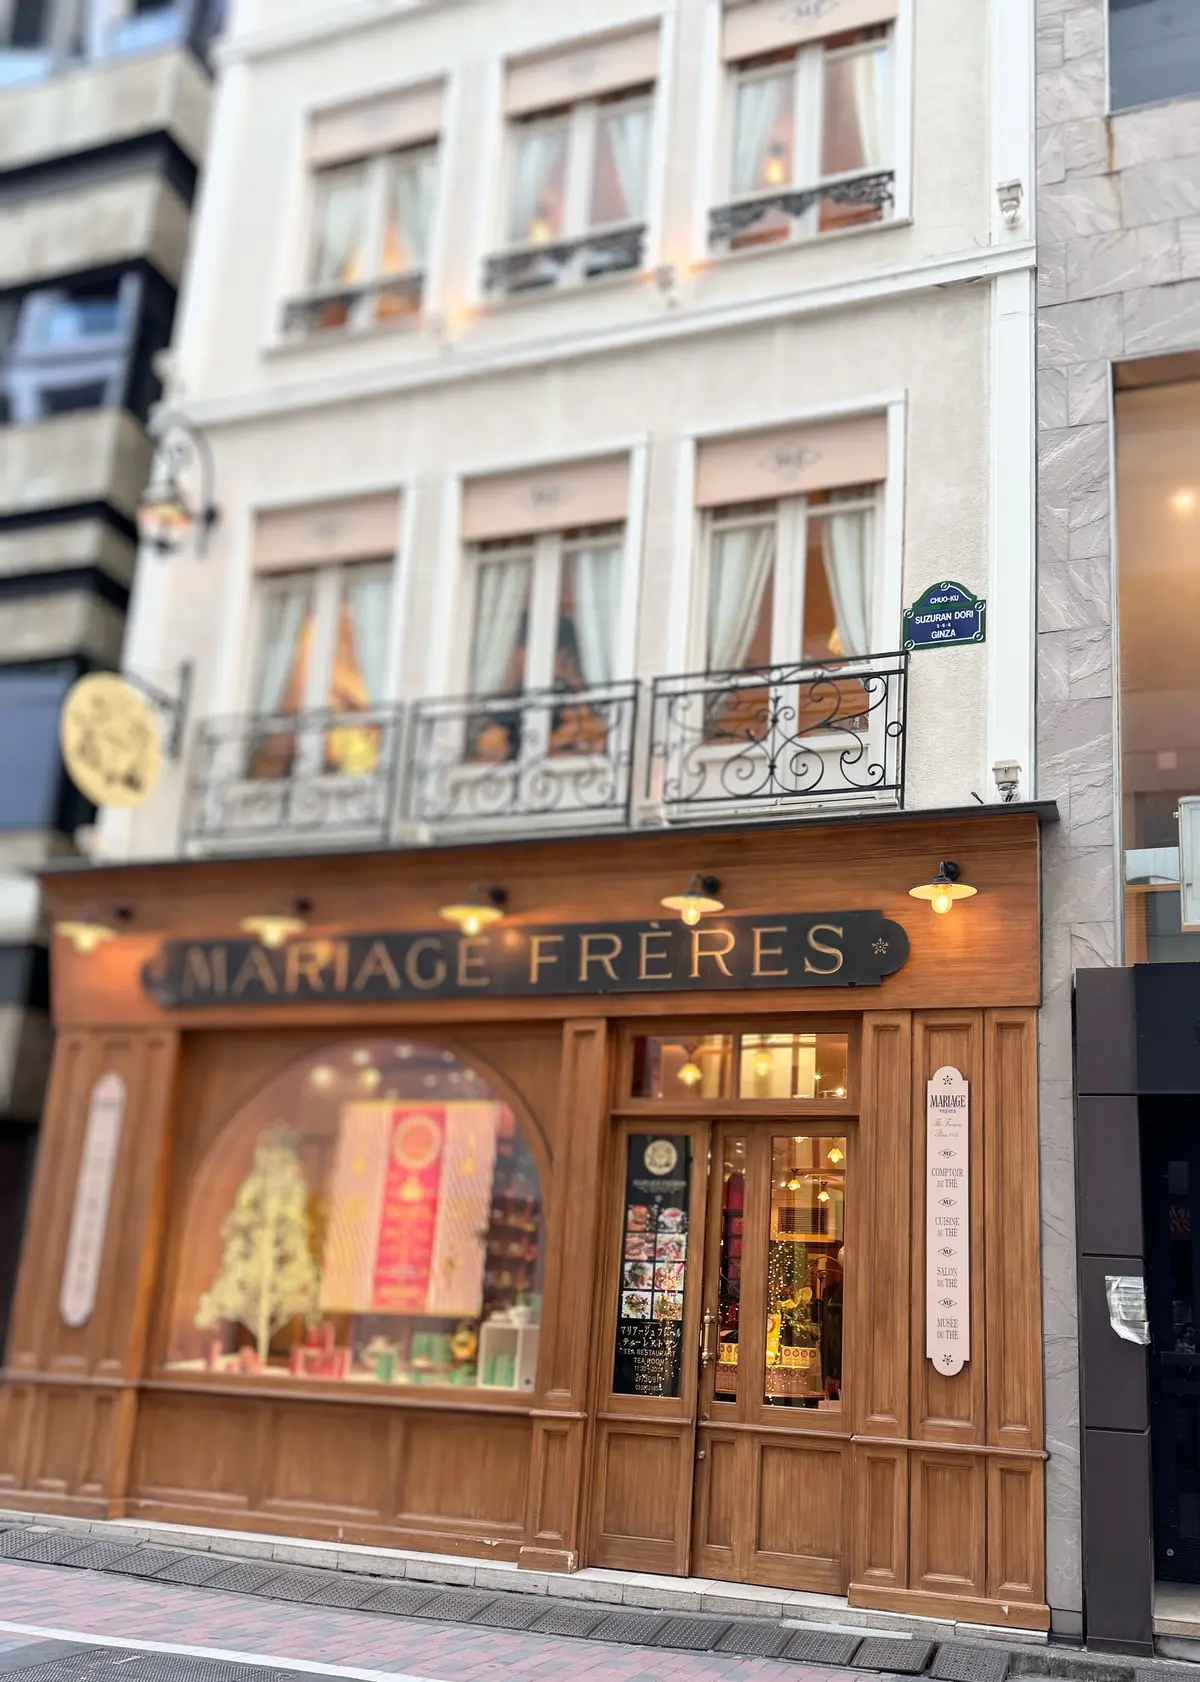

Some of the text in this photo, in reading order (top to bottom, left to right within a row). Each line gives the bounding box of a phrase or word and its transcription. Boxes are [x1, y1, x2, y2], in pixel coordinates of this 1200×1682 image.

[930, 595, 959, 604] CHUO-KU
[915, 610, 974, 624] SUZURAN DORI
[931, 628, 956, 639] GINZA
[181, 920, 845, 998] MARIAGE FRÈRES
[930, 1094, 966, 1108] MARIAGE
[931, 1167, 964, 1177] COMPTOIR
[935, 1216, 960, 1226] CUISINE
[937, 1266, 958, 1277] SALON
[937, 1316, 959, 1328] MUSÉE
